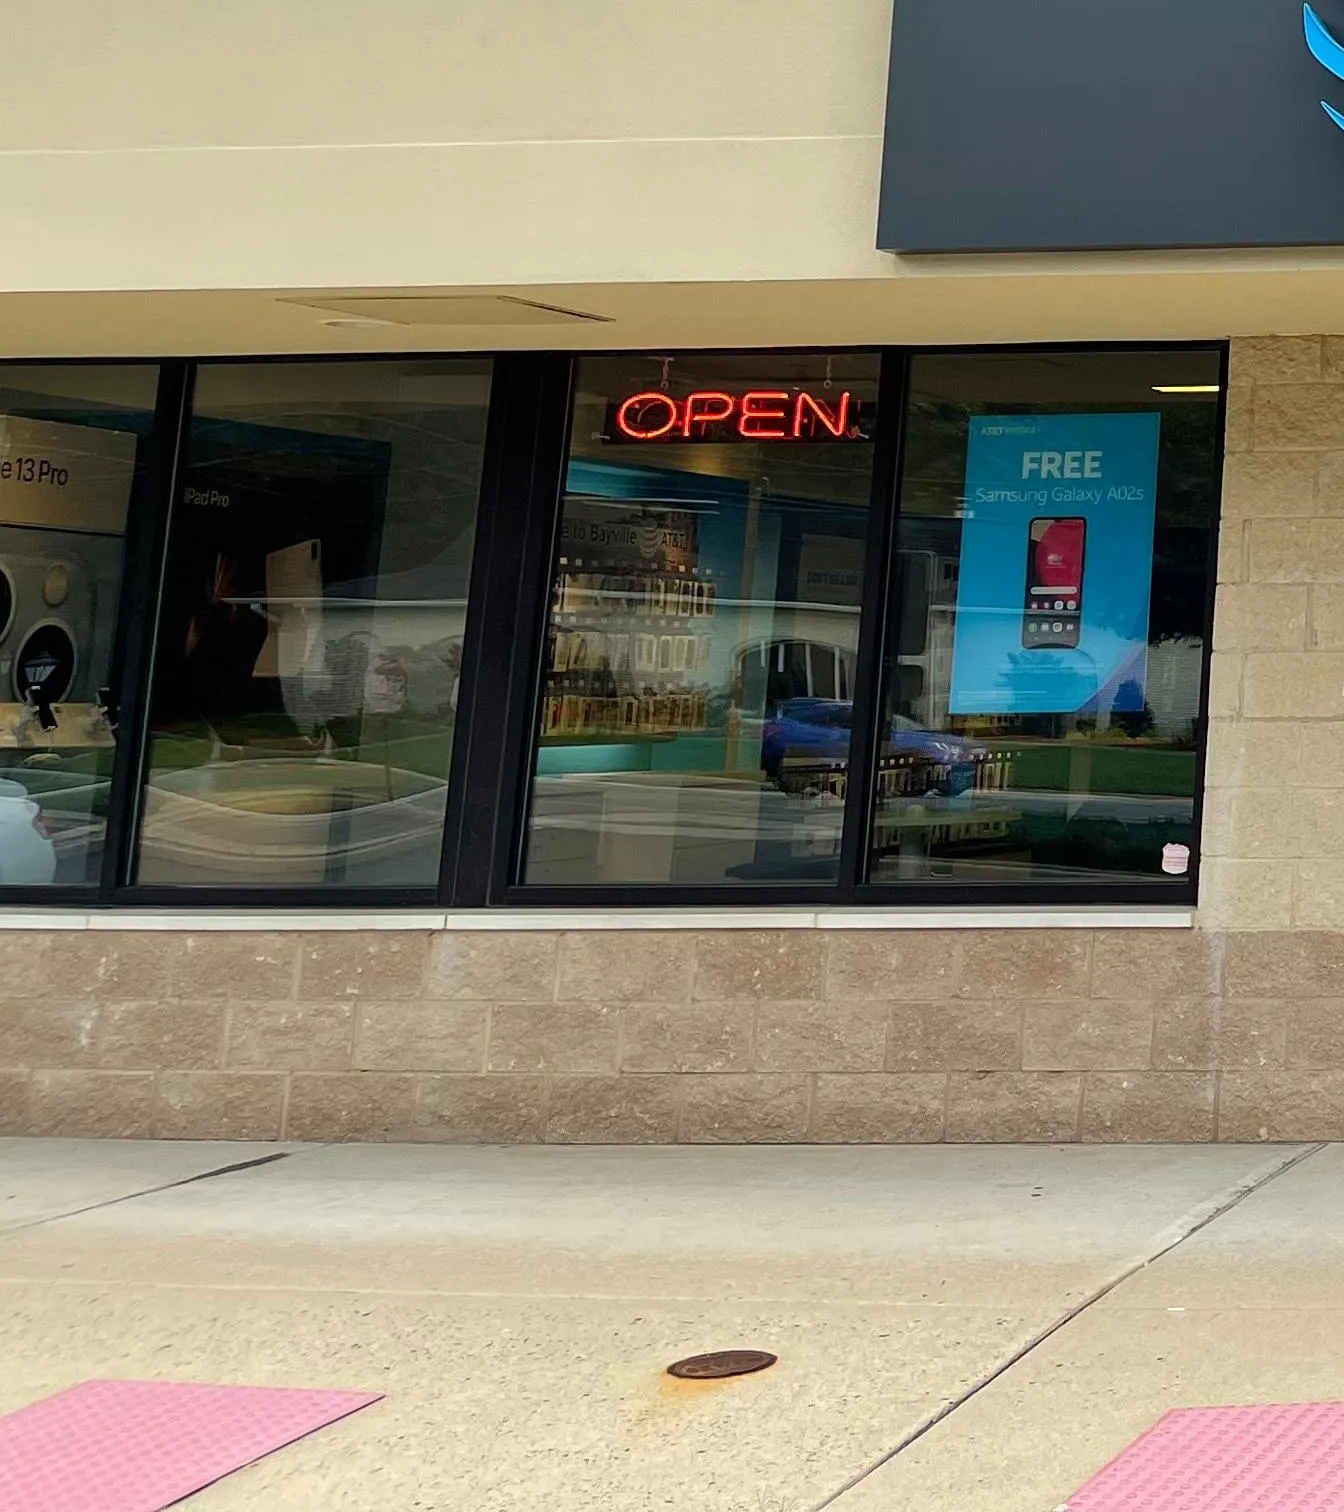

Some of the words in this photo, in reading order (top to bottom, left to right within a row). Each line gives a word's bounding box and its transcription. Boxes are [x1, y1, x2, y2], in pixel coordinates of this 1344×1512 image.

[617, 391, 850, 438] OPEN
[16, 457, 34, 482] 13
[38, 460, 69, 486] Pro
[1021, 450, 1103, 479] FREE
[210, 490, 230, 507] Pro
[975, 487, 1048, 506] Samsung
[1051, 486, 1103, 504] Galaxy
[1107, 485, 1145, 501] A02s
[590, 524, 637, 546] Bayville
[661, 531, 685, 548] AT&T
